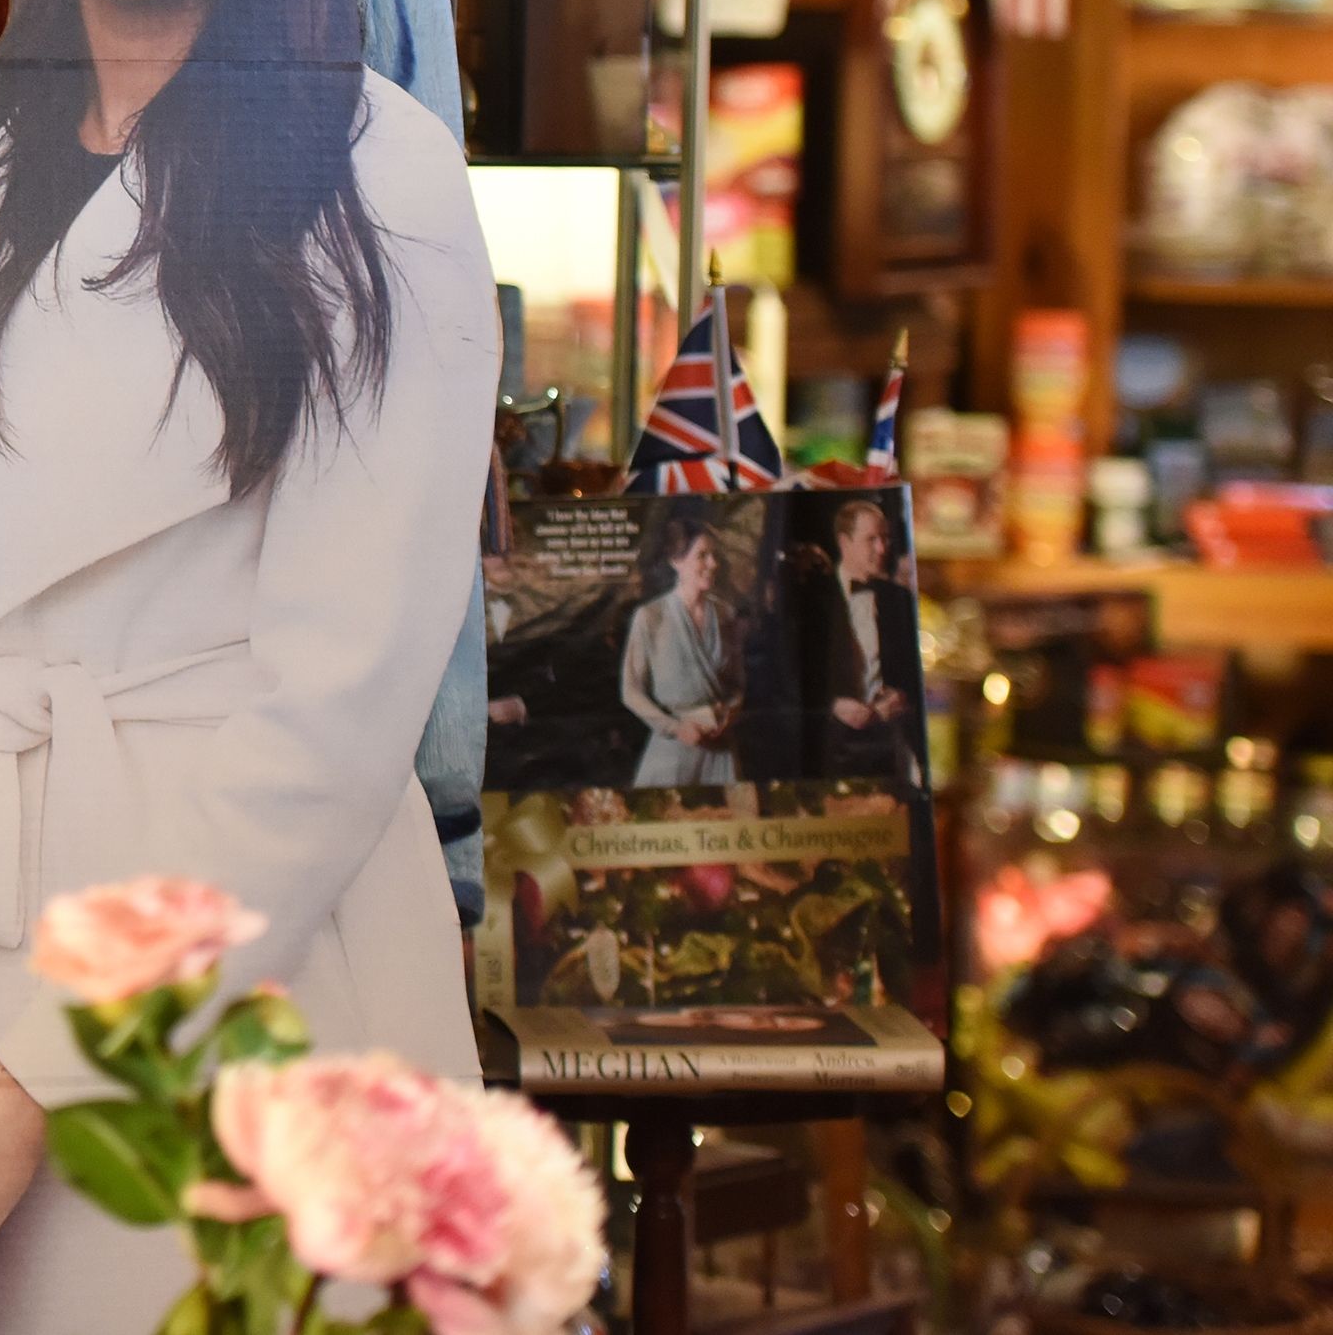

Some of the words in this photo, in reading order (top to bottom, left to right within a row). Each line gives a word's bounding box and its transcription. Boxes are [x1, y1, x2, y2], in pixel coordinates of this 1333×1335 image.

[569, 827, 689, 858] Christmas,
[694, 827, 730, 852] Tea
[735, 823, 755, 851] &
[541, 1050, 701, 1081] MEGHAN
